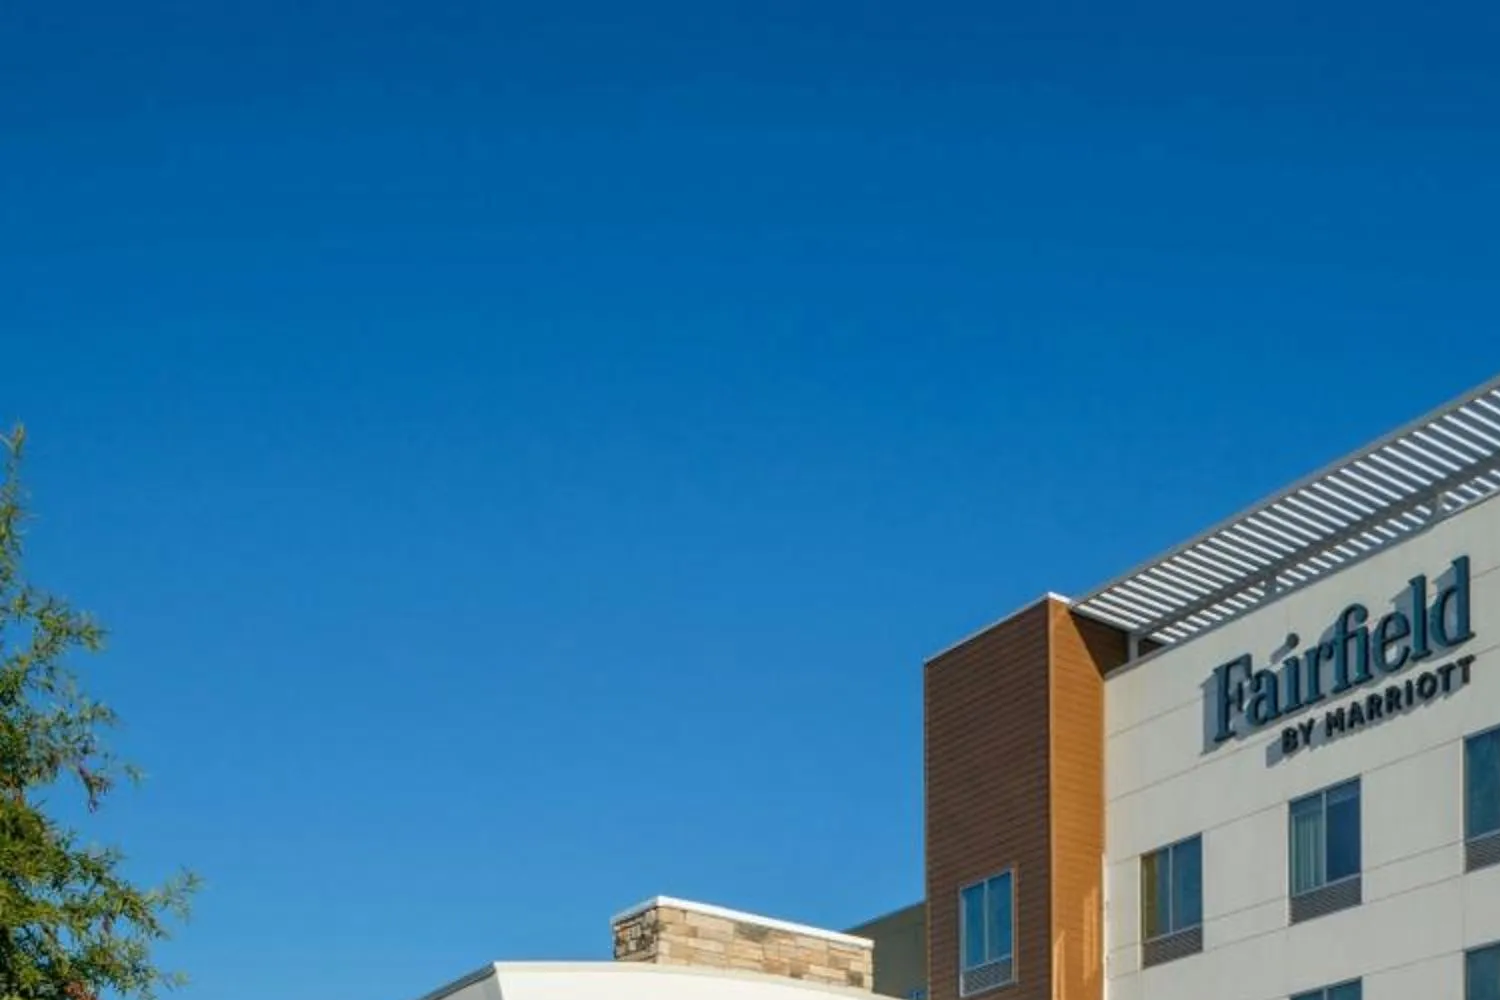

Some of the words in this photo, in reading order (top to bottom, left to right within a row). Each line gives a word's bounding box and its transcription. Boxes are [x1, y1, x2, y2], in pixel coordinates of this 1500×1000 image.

[1212, 555, 1476, 743] Fairfield
[1281, 718, 1315, 754] BY
[1325, 654, 1476, 737] MARRIOTT
